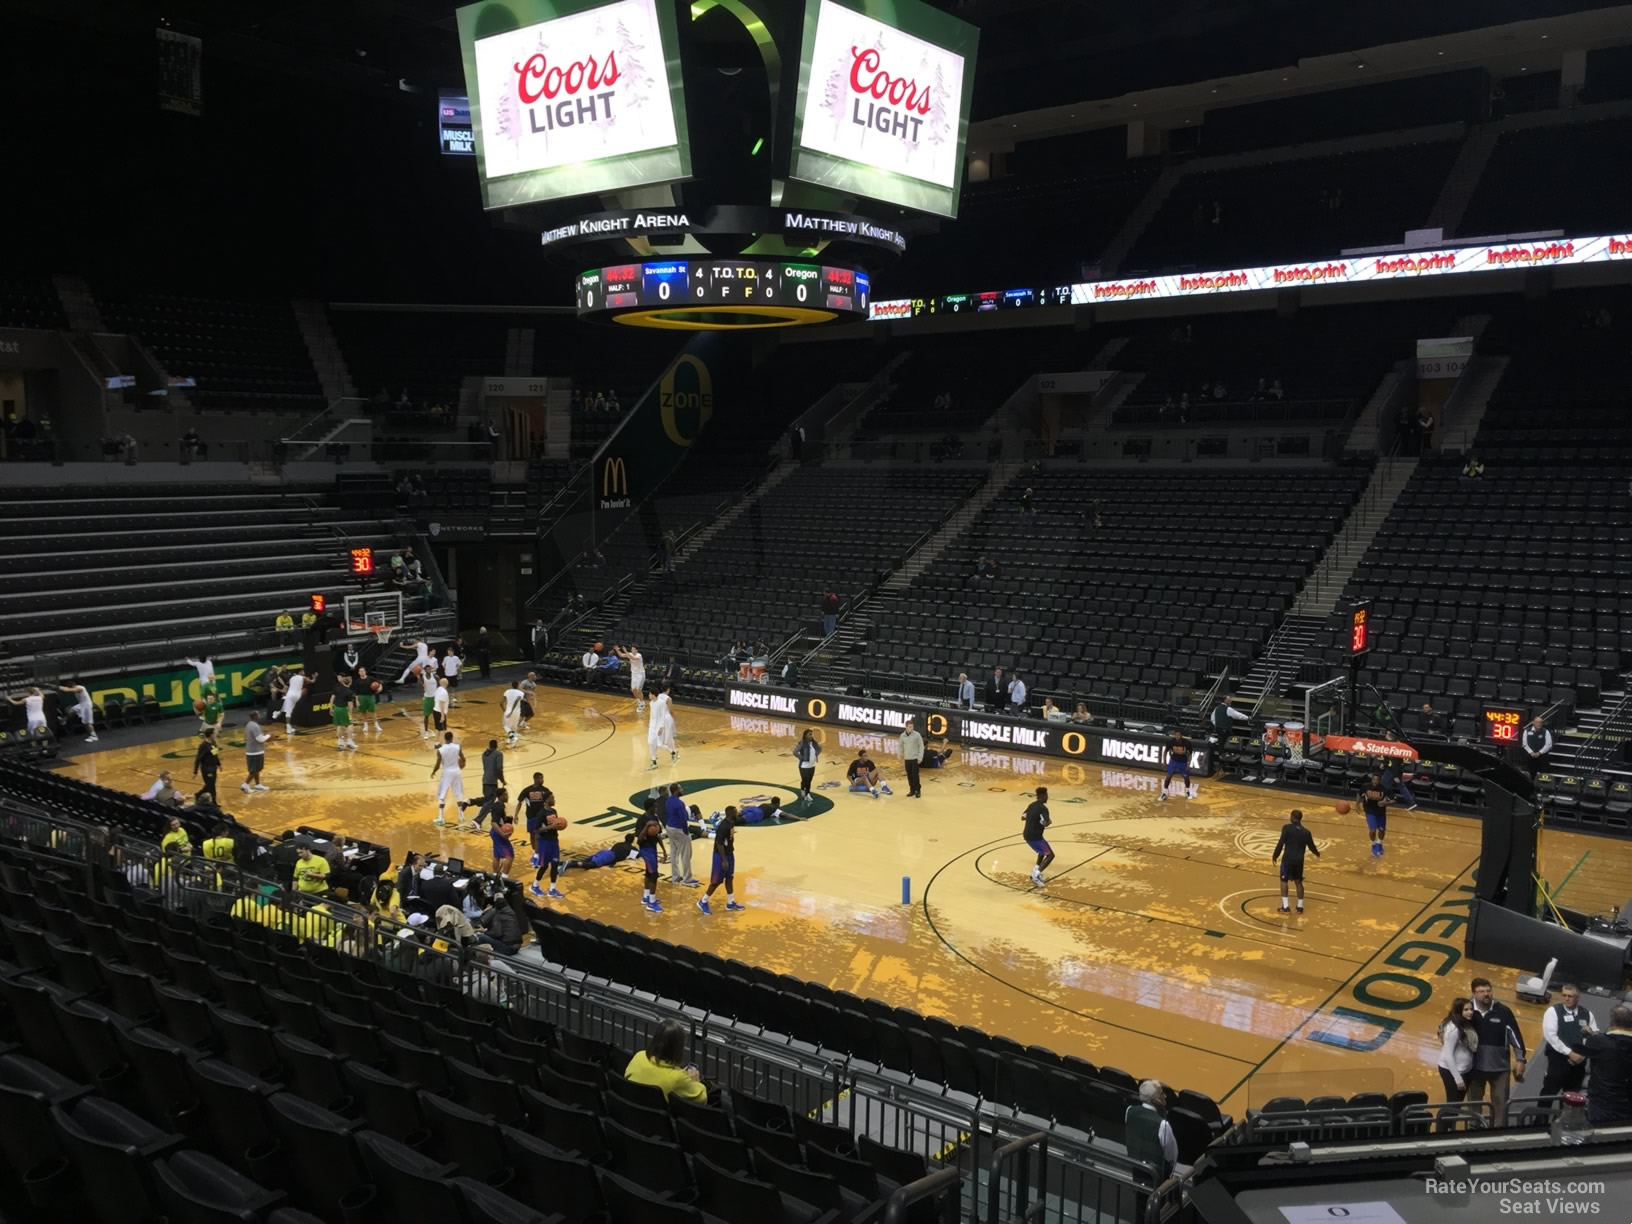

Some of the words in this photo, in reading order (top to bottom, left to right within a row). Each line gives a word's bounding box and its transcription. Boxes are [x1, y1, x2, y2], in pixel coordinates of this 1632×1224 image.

[514, 50, 622, 104] Coors
[850, 46, 931, 115] Coors
[443, 107, 470, 117] usban
[529, 91, 615, 134] LIGHT
[853, 98, 923, 142] LIGHT
[443, 129, 475, 140] MUSCL
[580, 218, 630, 235] KNIGHT
[634, 213, 690, 229] ARENA
[785, 213, 858, 235] MATTHEW
[859, 221, 894, 241] KNIGHT
[645, 267, 677, 275] Savannah
[695, 268, 703, 278] 4
[765, 269, 773, 280] 4
[785, 267, 818, 279] Oregon
[658, 282, 670, 300] 0
[696, 286, 704, 297] 0
[721, 287, 730, 297] F
[745, 287, 753, 297] F
[766, 287, 773, 298] 0
[796, 284, 807, 301] 0
[587, 290, 593, 307] 0
[1060, 296, 1065, 304] F
[953, 304, 959, 312] 0
[488, 384, 504, 392] 120
[353, 557, 370, 571] 30
[730, 689, 769, 709] MUSCLE
[770, 698, 796, 713] MILK
[838, 703, 882, 725] MUSCLE
[1486, 711, 1520, 725] 44:32
[1012, 727, 1046, 747] MILK
[1493, 723, 1511, 739] 30
[1101, 738, 1160, 763] MUSCLE
